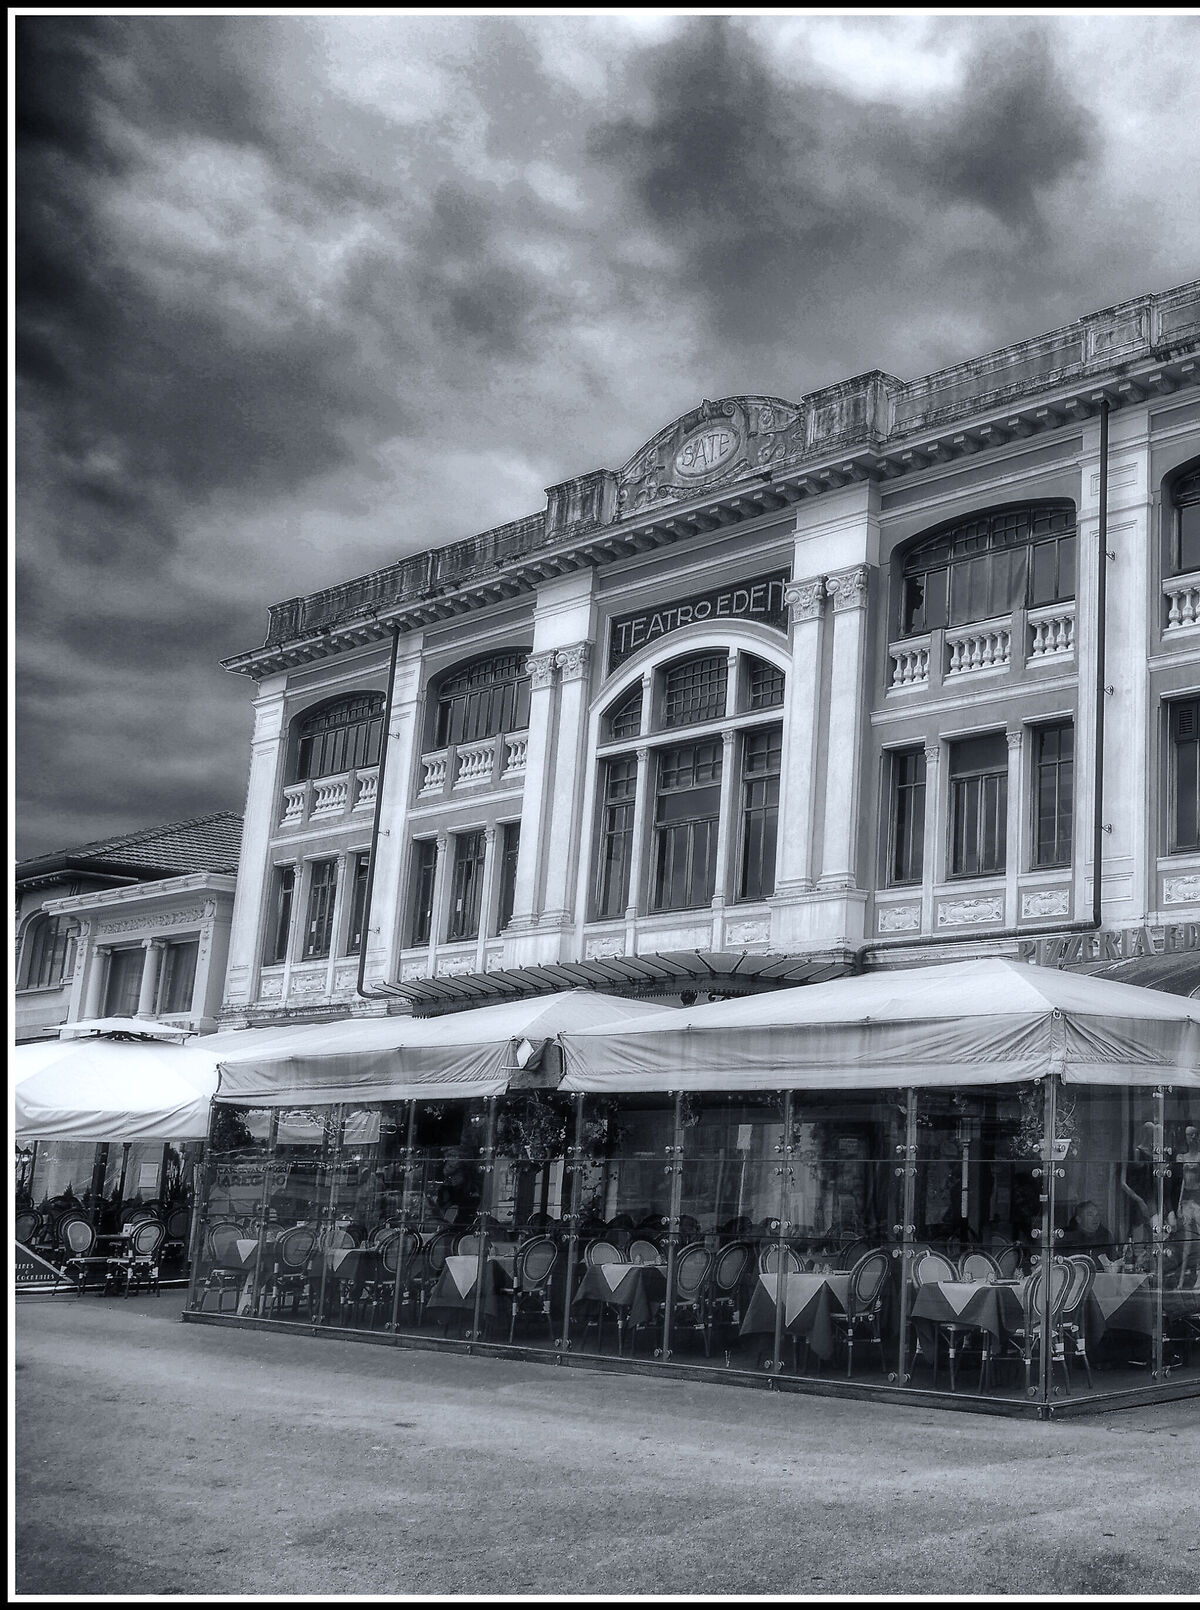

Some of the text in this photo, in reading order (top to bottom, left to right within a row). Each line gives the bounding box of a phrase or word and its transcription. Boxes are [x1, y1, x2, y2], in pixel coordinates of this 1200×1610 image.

[617, 578, 786, 652] TEATRO EDEN
[1018, 926, 1157, 967] PIZZERIA
